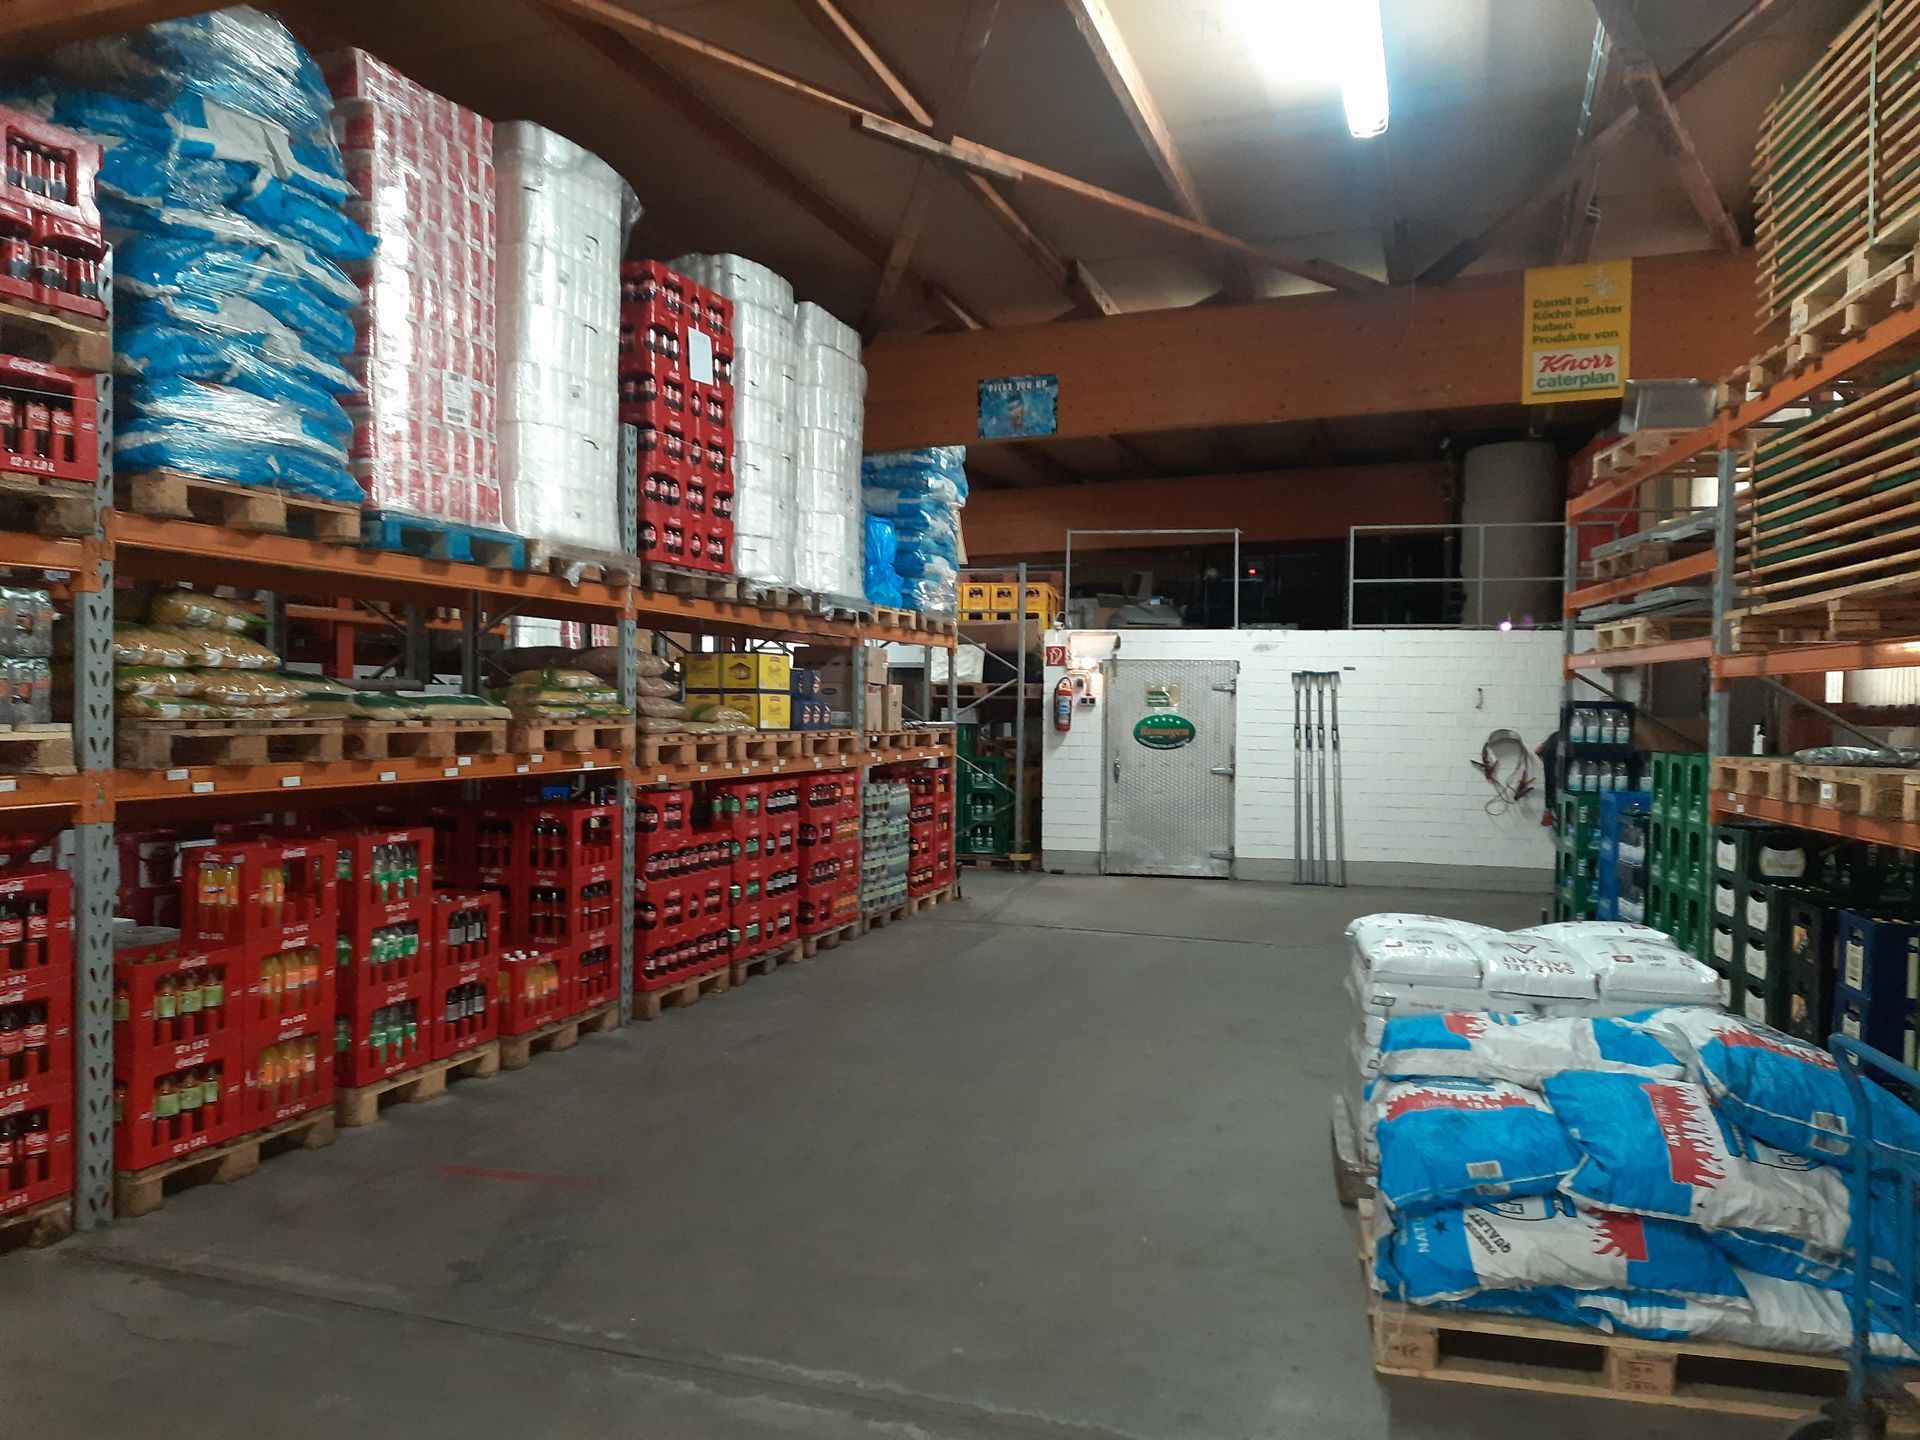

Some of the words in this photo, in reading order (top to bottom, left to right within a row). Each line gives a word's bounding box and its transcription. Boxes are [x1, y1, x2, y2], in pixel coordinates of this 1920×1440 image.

[1534, 297, 1572, 308] Damit
[1575, 305, 1622, 317] leichter
[1532, 331, 1591, 344] Produkte
[1594, 329, 1619, 339] von
[1538, 352, 1616, 374] Knorr
[1536, 370, 1616, 389] caterplan
